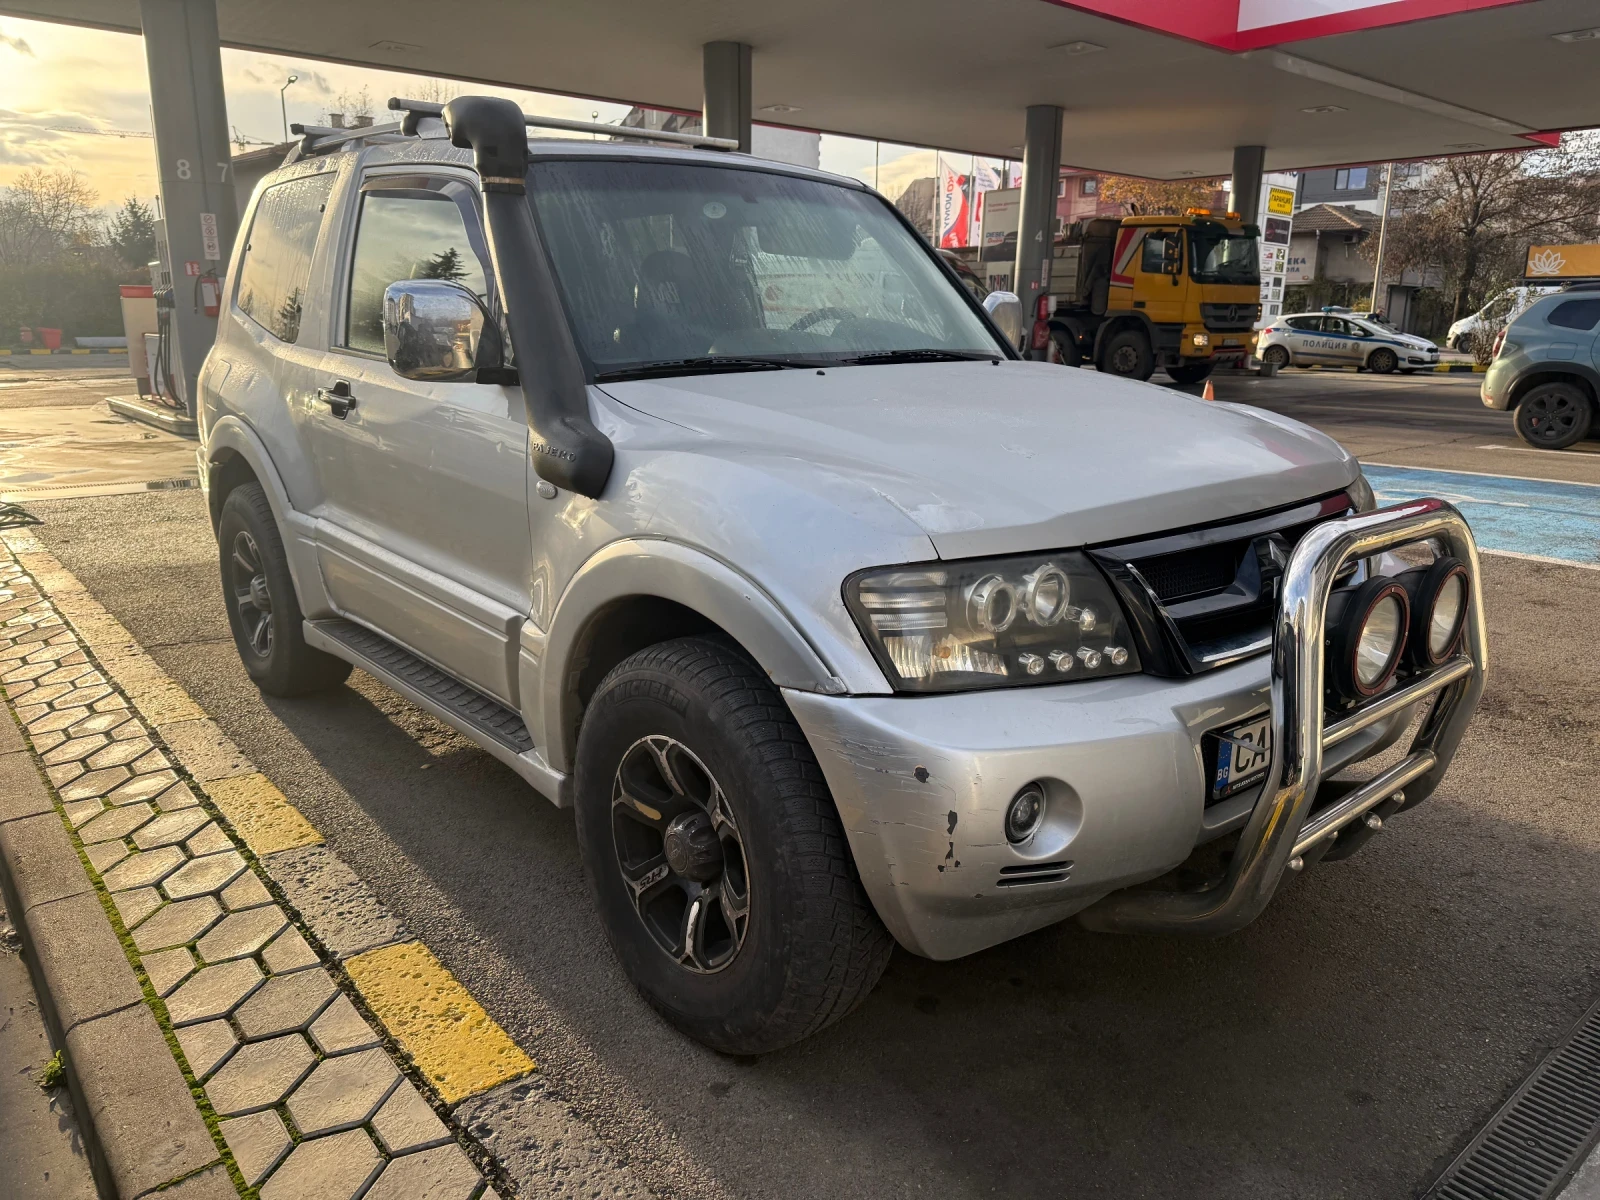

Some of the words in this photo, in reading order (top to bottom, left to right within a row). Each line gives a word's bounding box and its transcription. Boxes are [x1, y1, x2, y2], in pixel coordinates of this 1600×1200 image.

[176, 159, 191, 180] 8
[216, 162, 228, 183] 7
[1035, 230, 1043, 242] 4
[1287, 257, 1307, 265] ЕКА
[1302, 339, 1347, 350] ПОЛИЦИЯ
[532, 442, 577, 462] PAJERO
[613, 679, 690, 716] MICHELIN
[1235, 725, 1266, 773] CA
[1216, 766, 1229, 781] BG
